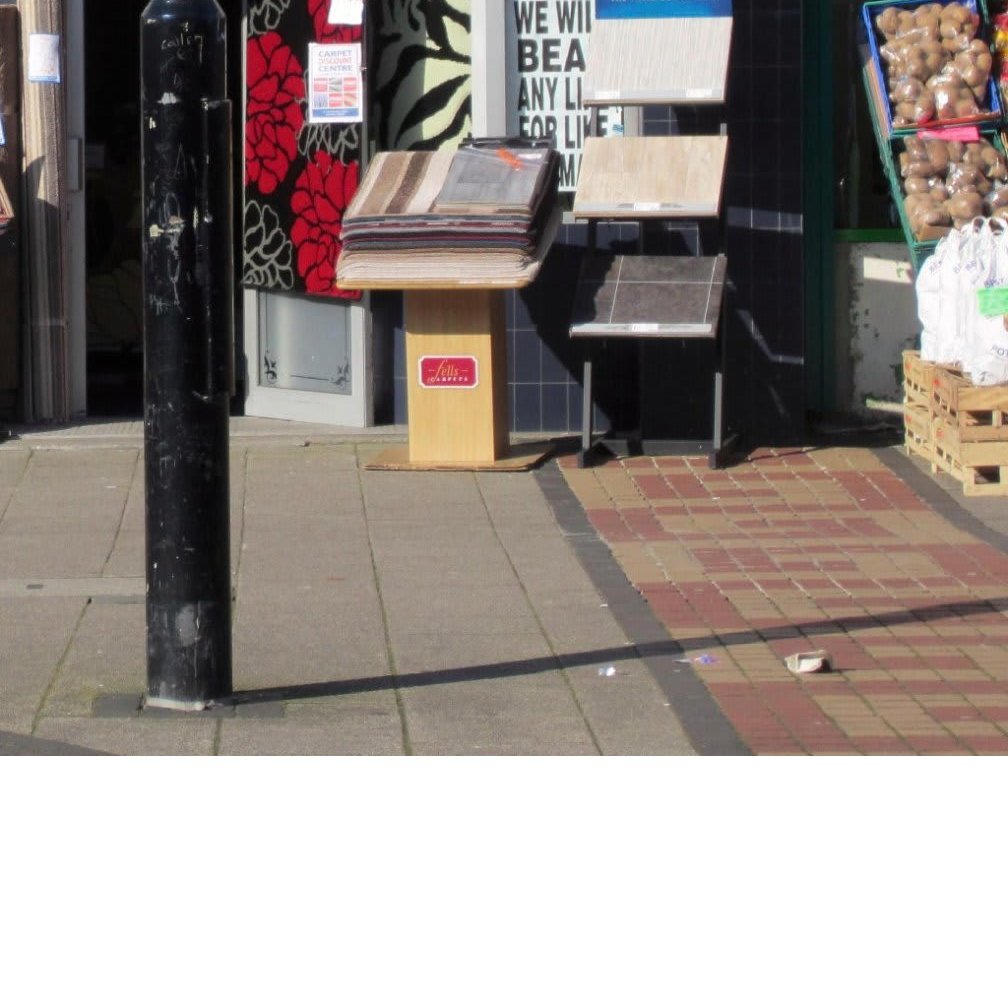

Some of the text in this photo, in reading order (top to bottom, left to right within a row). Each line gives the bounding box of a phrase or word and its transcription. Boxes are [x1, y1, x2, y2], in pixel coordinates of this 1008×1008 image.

[514, 0, 592, 34] WE WI
[319, 50, 352, 58] CARPET
[518, 38, 587, 73] BEA
[518, 77, 582, 111] ANY LI
